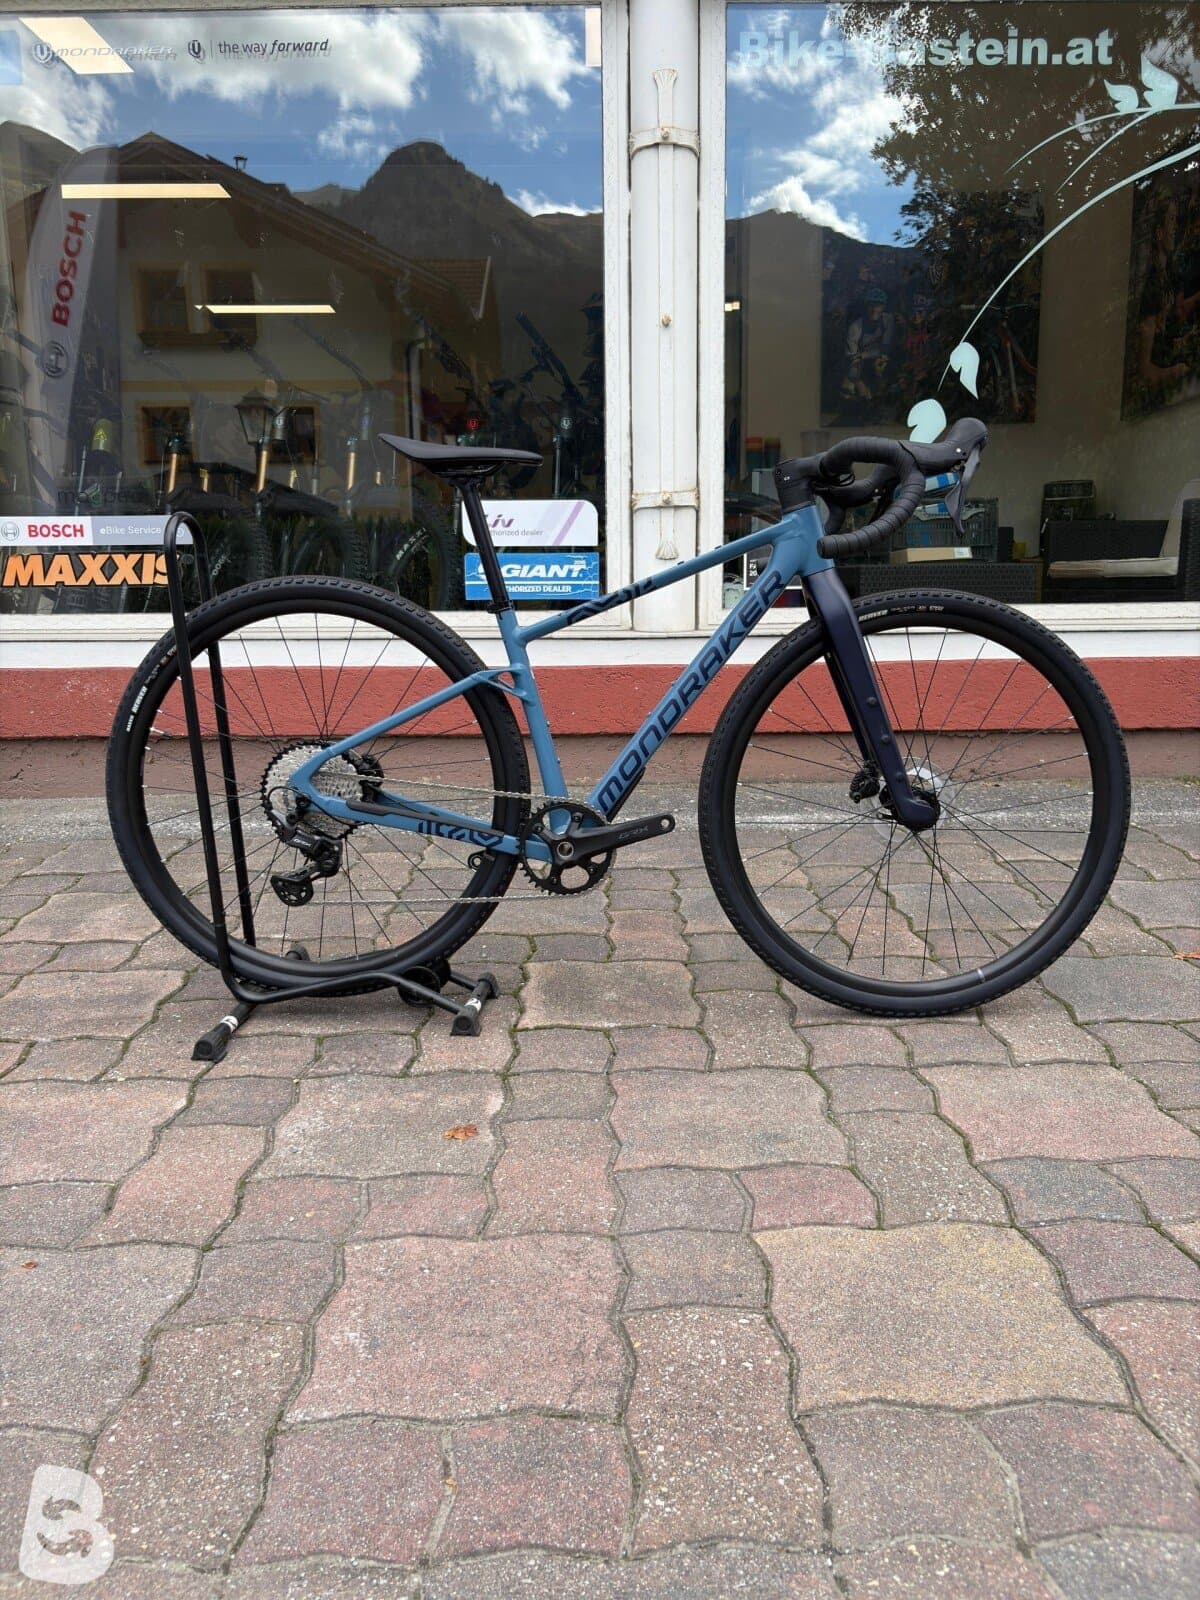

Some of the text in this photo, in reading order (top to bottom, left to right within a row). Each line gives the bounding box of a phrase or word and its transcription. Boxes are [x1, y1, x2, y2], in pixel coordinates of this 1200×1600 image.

[218, 39, 329, 56] the way forward
[51, 210, 88, 328] BOSCH
[27, 524, 161, 538] BOSCH eBike Service
[520, 528, 545, 537] dealer
[501, 563, 586, 578] GIANT
[542, 585, 572, 593] DEALER
[597, 569, 784, 814] MONDRAKER
